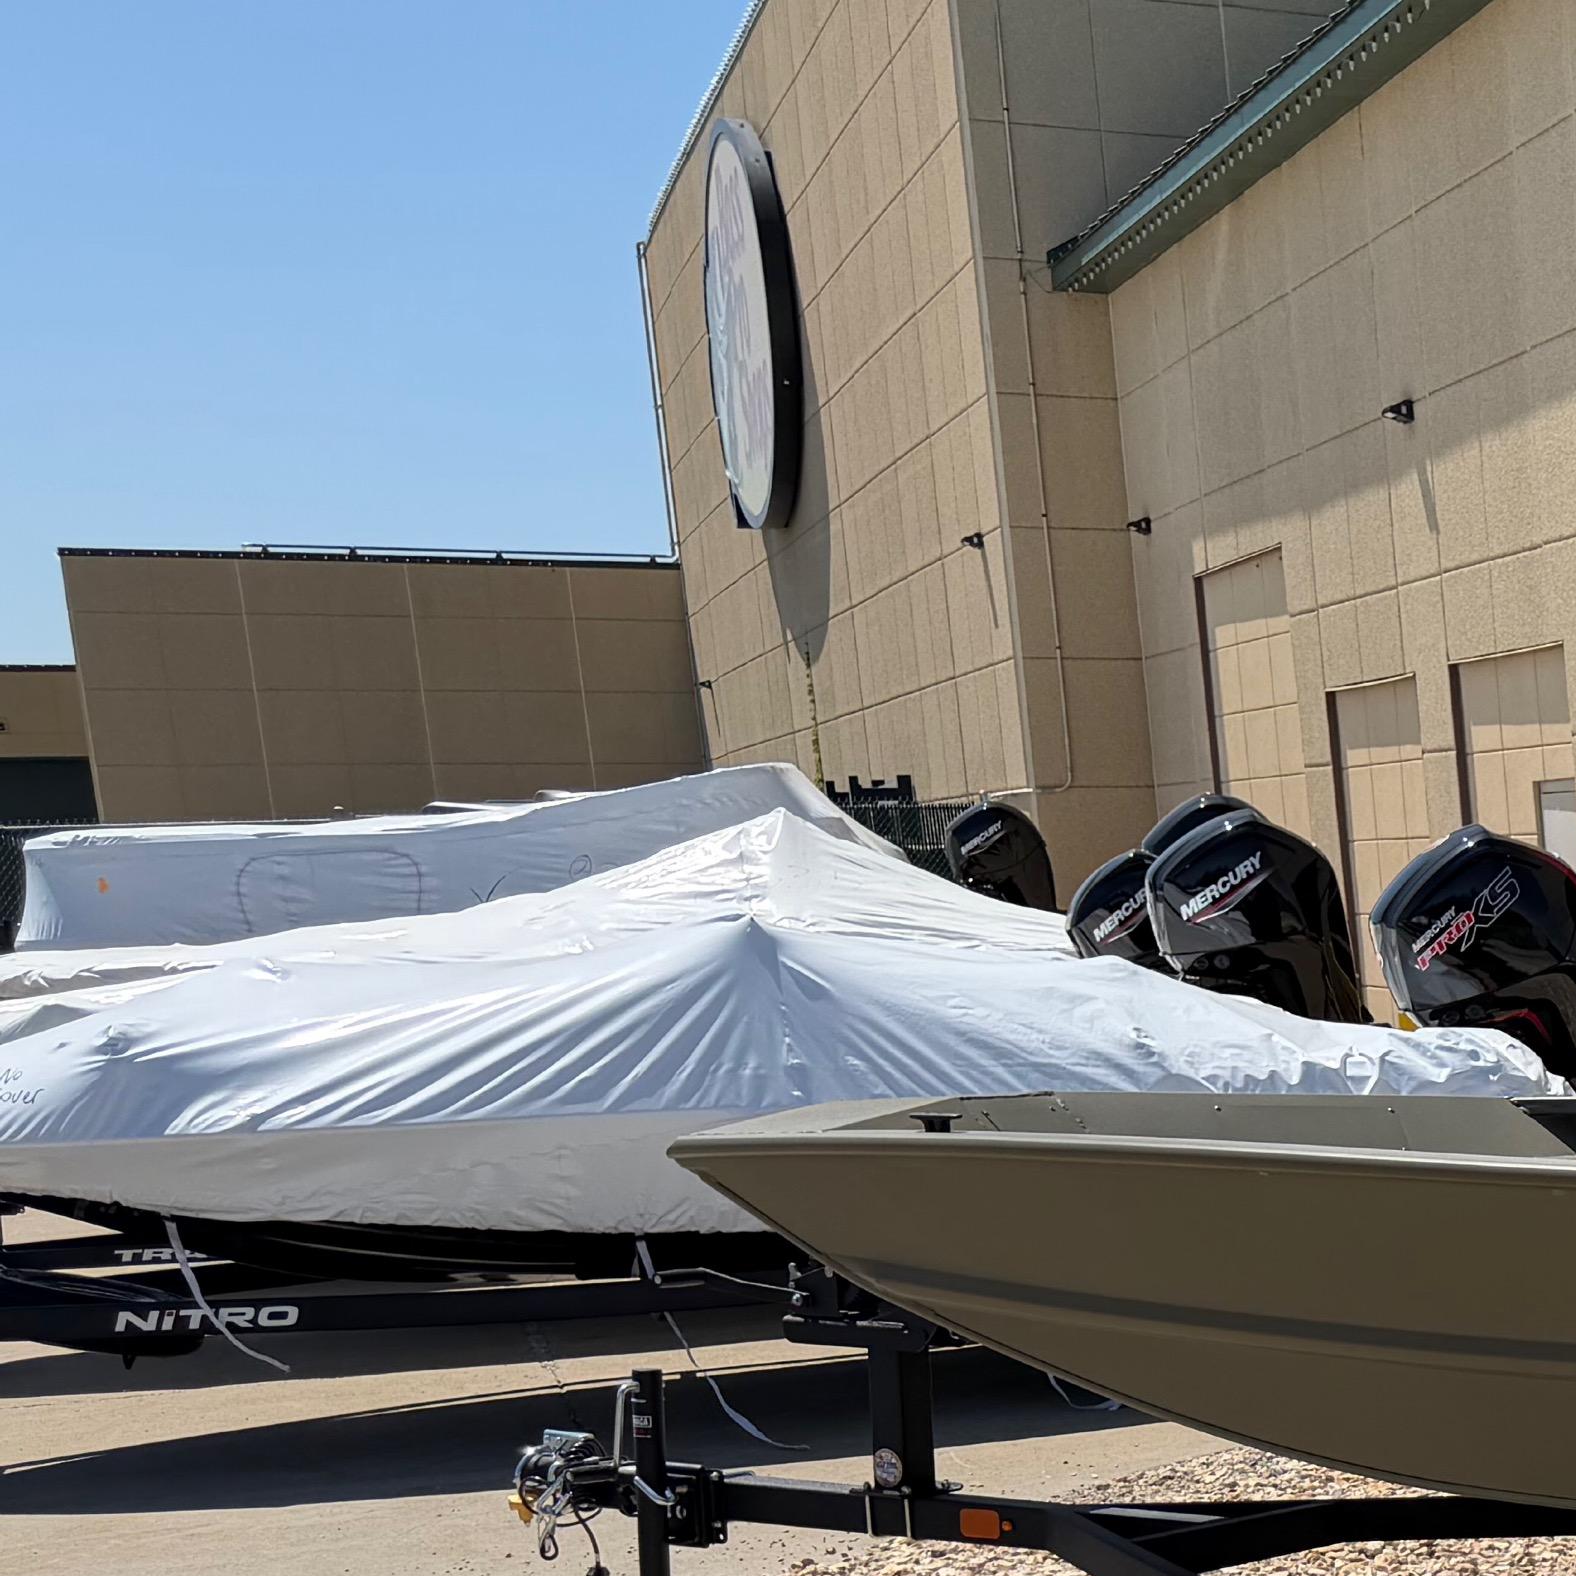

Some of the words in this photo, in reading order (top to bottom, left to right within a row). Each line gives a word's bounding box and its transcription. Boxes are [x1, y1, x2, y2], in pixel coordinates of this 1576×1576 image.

[960, 820, 1002, 855] MERCURY
[1180, 850, 1262, 922] MERCURY
[1093, 888, 1148, 942] MERCUR
[1412, 905, 1456, 953] MERCURY
[0, 1088, 45, 1104] over
